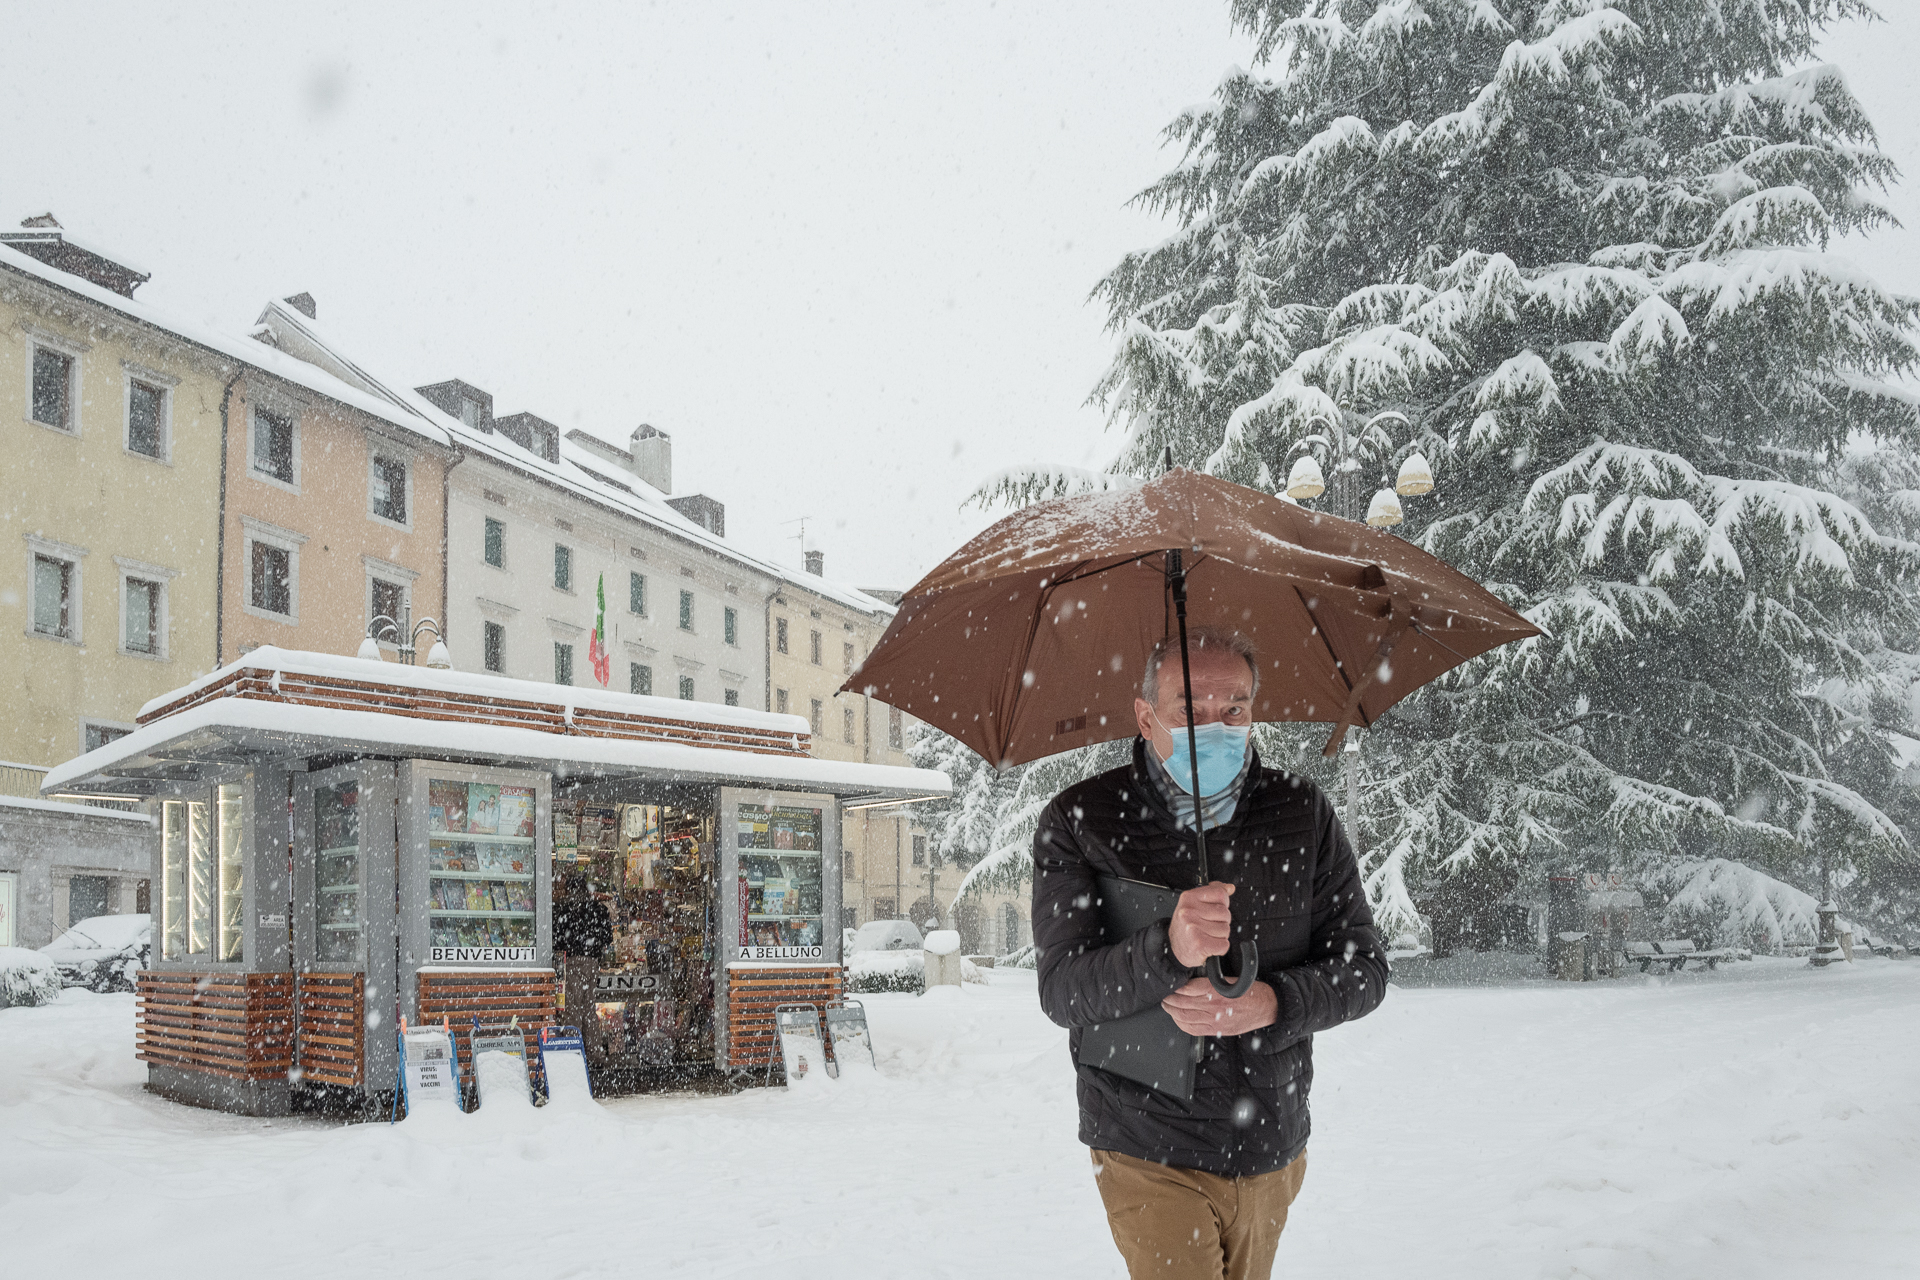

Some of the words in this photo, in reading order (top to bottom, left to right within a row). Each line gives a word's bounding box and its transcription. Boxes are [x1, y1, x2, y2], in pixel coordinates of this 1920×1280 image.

[432, 948, 535, 961] BENVENUTI
[740, 947, 751, 959] A
[756, 947, 822, 959] BELLUNO
